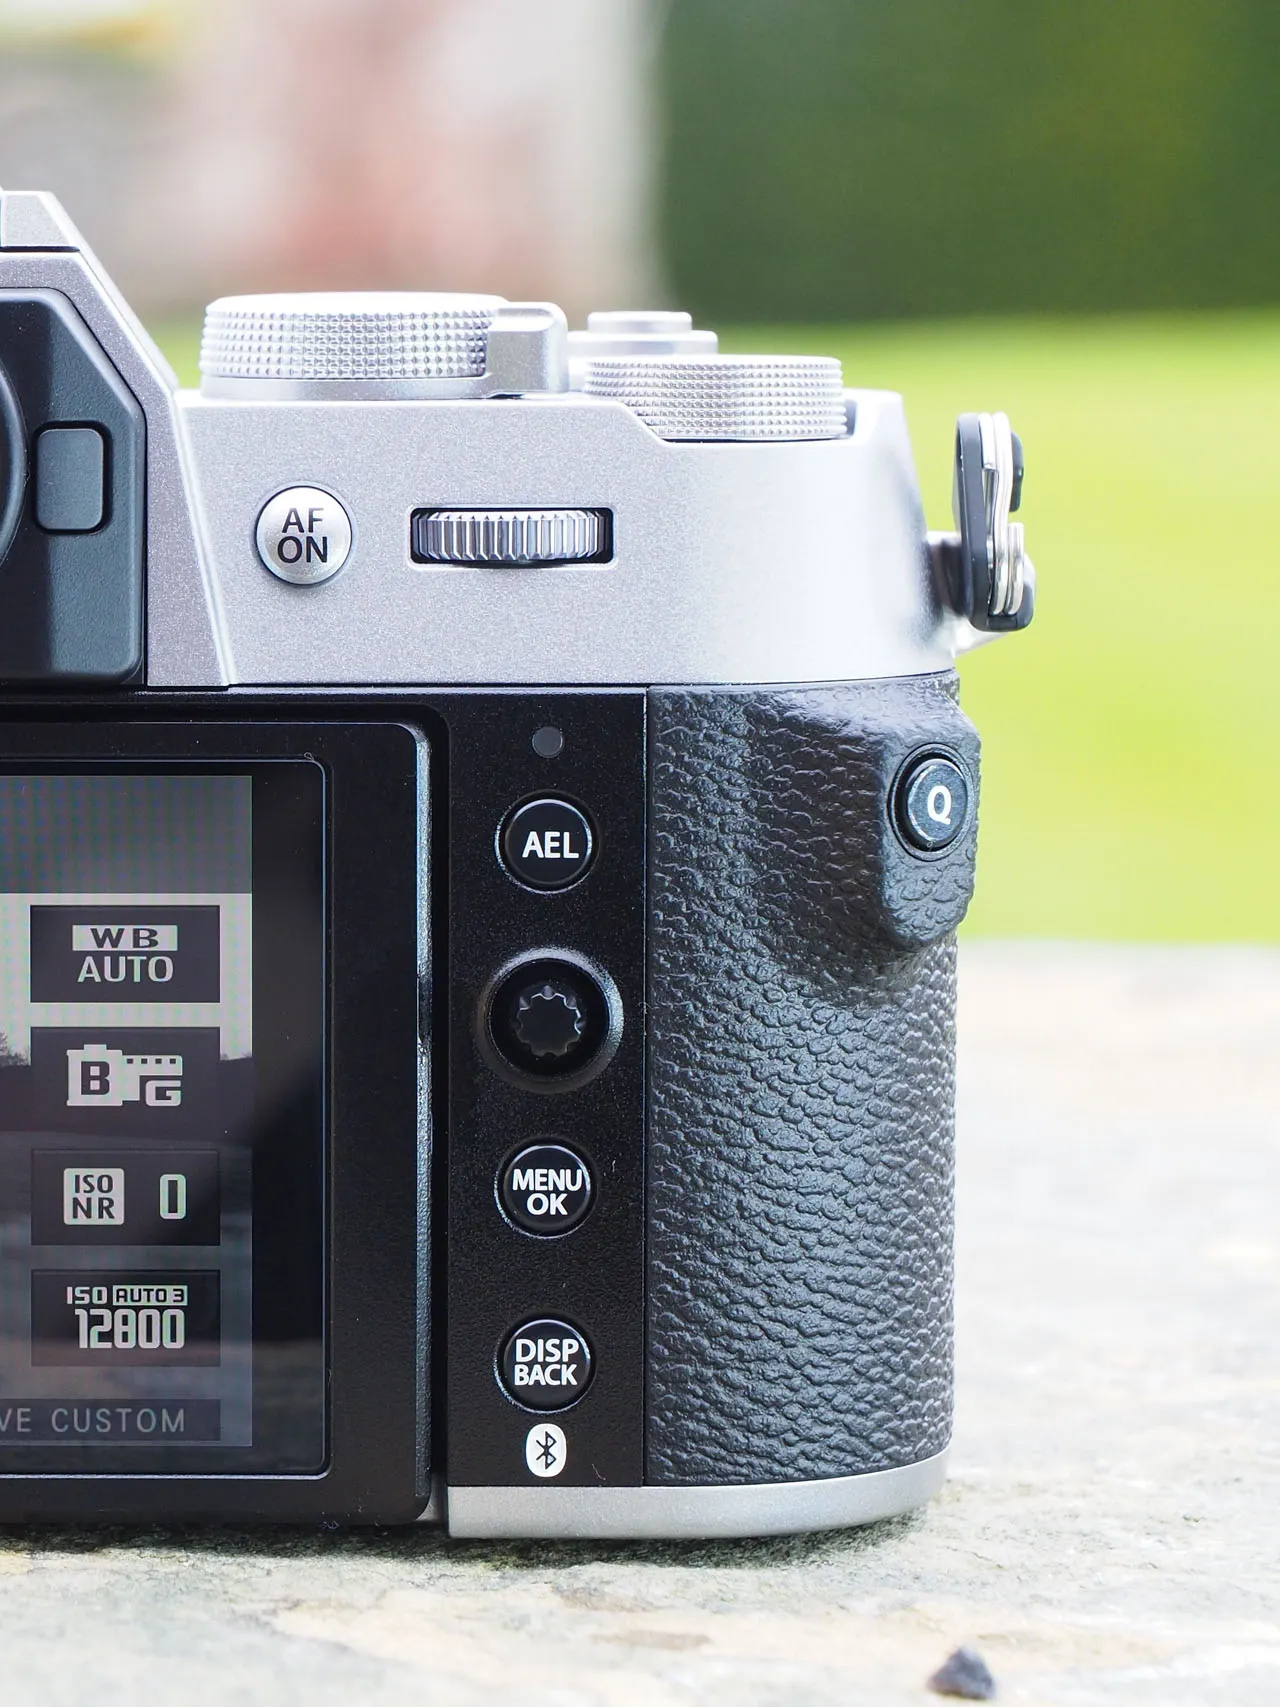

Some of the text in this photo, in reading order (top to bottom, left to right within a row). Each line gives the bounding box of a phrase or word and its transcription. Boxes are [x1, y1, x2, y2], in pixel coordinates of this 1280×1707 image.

[281, 507, 324, 533] AF
[276, 535, 329, 564] ON
[927, 785, 952, 825] Q
[522, 830, 579, 859] AEL
[77, 956, 174, 982] AUTO
[74, 1174, 113, 1194] ISO
[512, 1168, 583, 1192] MENU
[72, 1197, 115, 1219] NR
[159, 1173, 186, 1219] 0
[526, 1192, 568, 1216] OK
[67, 1286, 108, 1304] ISO
[116, 1288, 167, 1302] AUTO
[74, 1308, 185, 1349] 12800
[515, 1338, 579, 1363] DISP
[514, 1363, 577, 1386] BACK
[51, 1407, 185, 1433] CUSTOM
